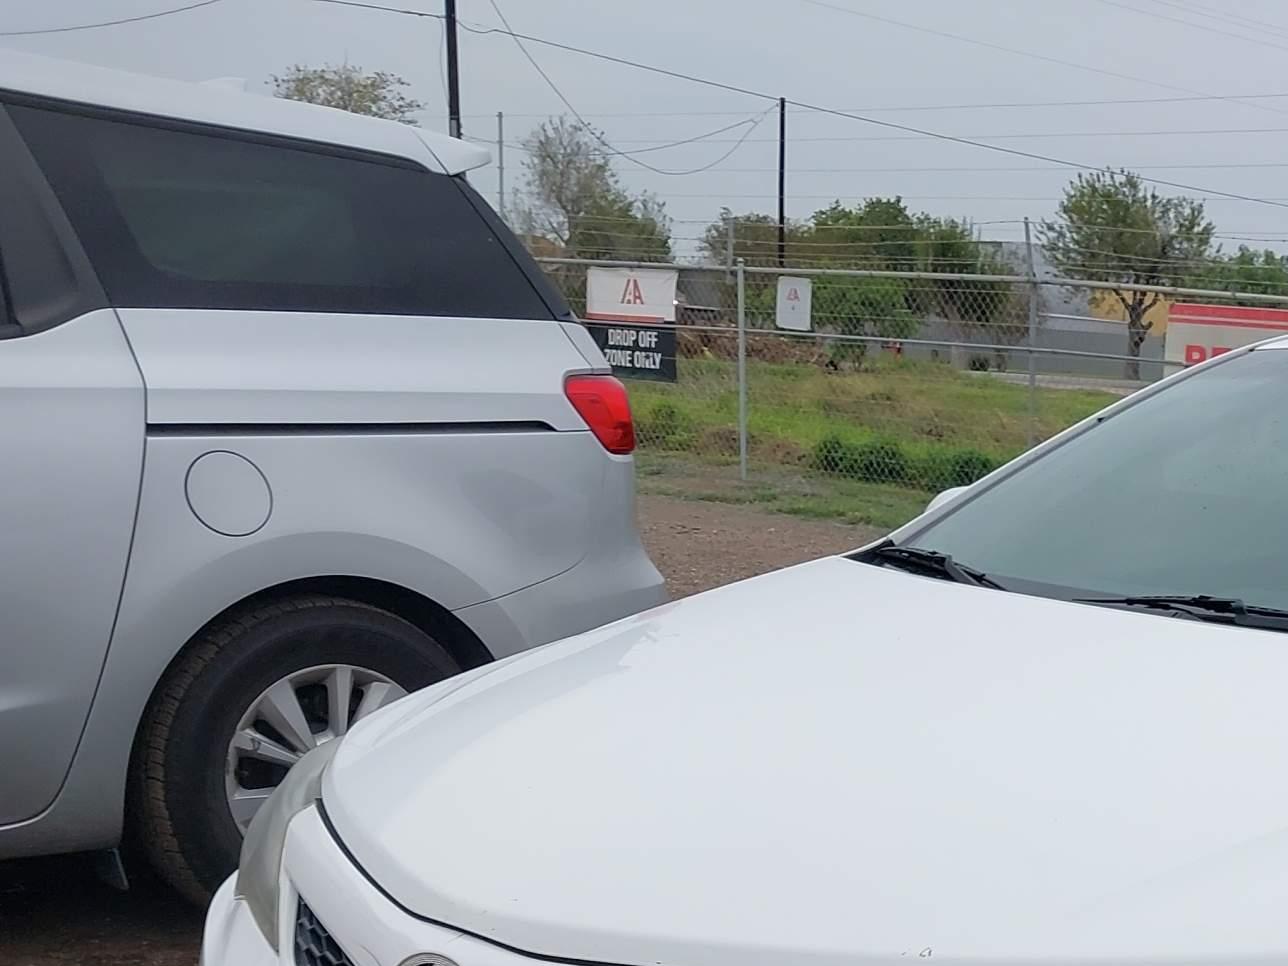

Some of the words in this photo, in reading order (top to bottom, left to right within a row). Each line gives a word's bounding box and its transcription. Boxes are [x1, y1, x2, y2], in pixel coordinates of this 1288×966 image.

[607, 328, 637, 346] DROP
[638, 331, 658, 348] OFF
[604, 349, 632, 367] ZONE
